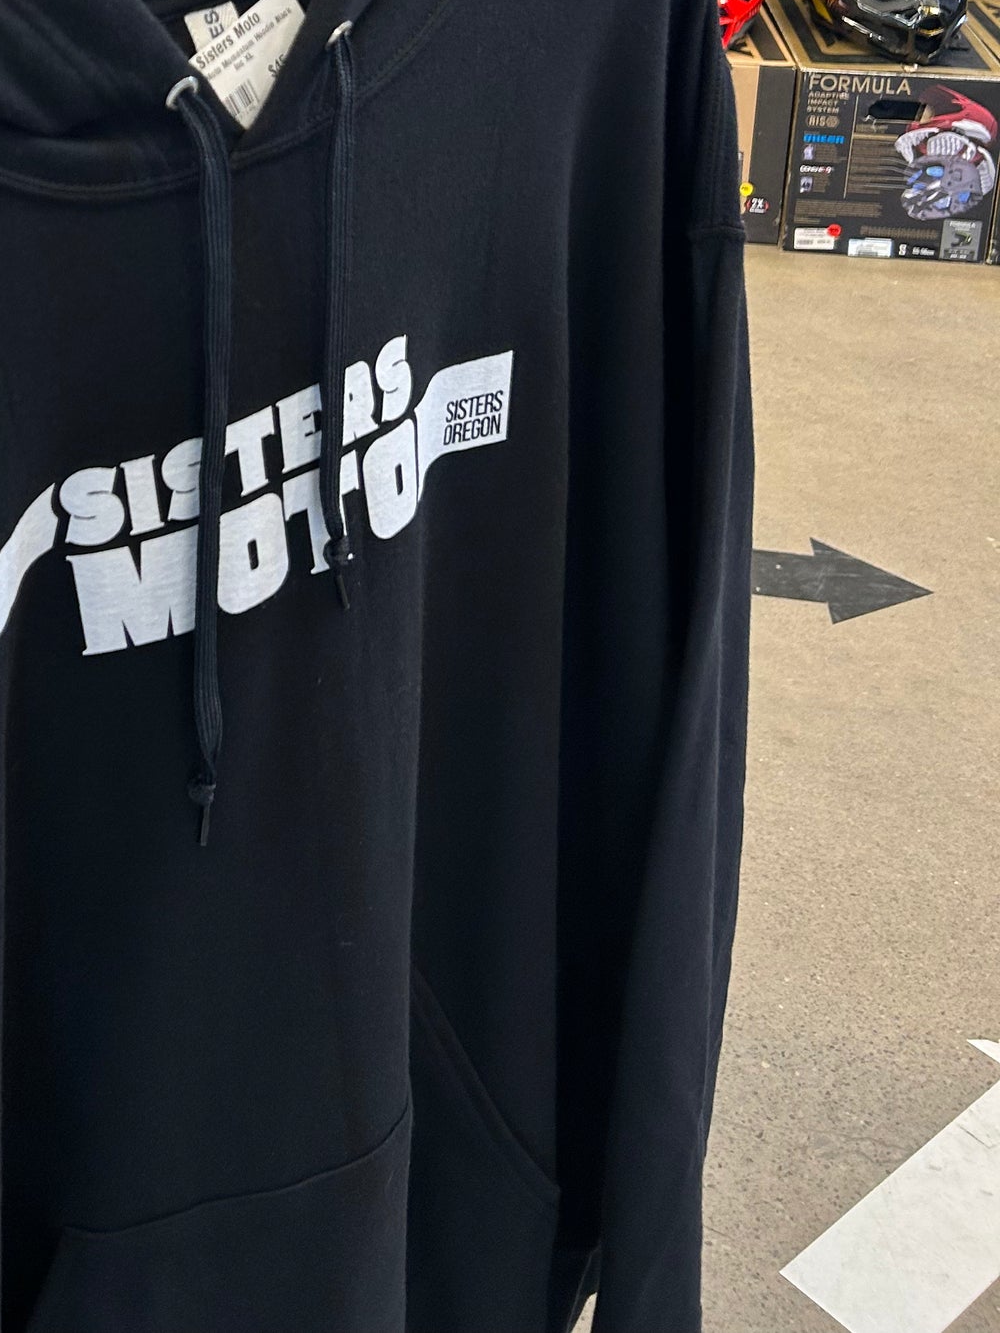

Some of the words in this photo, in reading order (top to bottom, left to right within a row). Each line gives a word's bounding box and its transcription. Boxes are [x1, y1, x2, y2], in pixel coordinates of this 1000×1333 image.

[195, 34, 234, 69] Sisters
[233, 12, 260, 39] Moto
[808, 74, 911, 95] FORMULA
[446, 390, 504, 422] SISTERS
[59, 334, 412, 546] SISTERS
[443, 415, 501, 446] OREGON
[66, 418, 418, 656] MOTO
